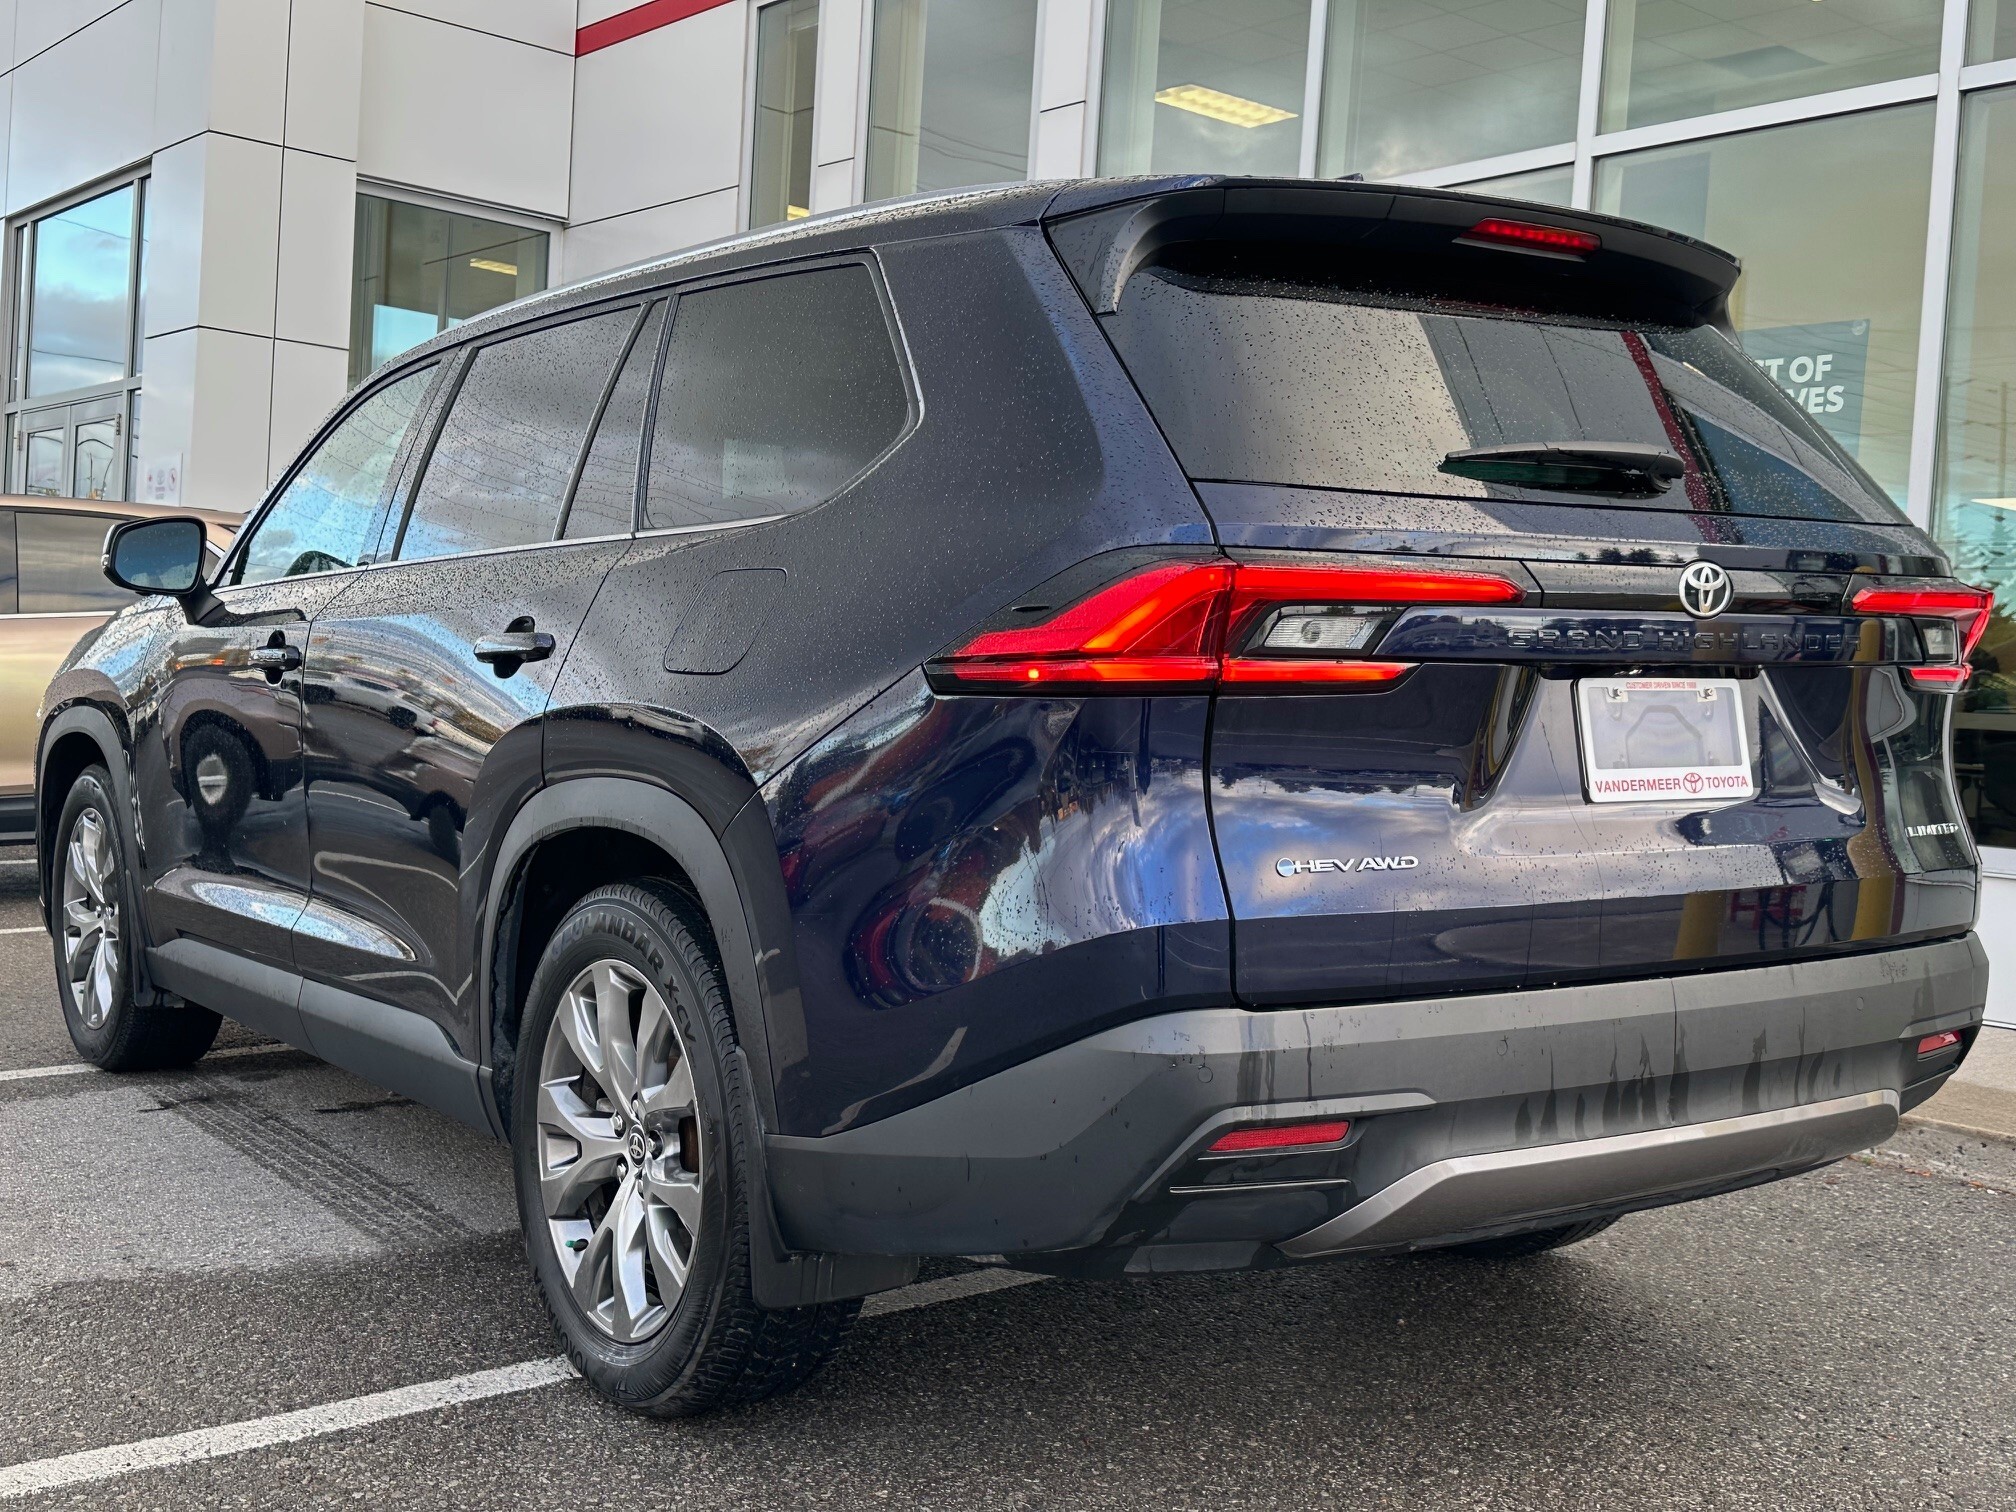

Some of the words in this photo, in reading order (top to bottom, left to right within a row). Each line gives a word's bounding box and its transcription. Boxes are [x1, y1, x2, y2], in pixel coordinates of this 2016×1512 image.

[1789, 354, 1833, 383] OF
[1507, 629, 1644, 650] GRAND
[1658, 631, 1861, 651] HIGHLANDER
[1595, 778, 1681, 793] VANDERMEER
[1705, 776, 1749, 789] TOYOTA
[1905, 822, 1959, 837] LIMITED
[1355, 855, 1419, 872] AWD
[551, 912, 665, 974] GEOLANDAR
[663, 975, 697, 1043] X-CV
